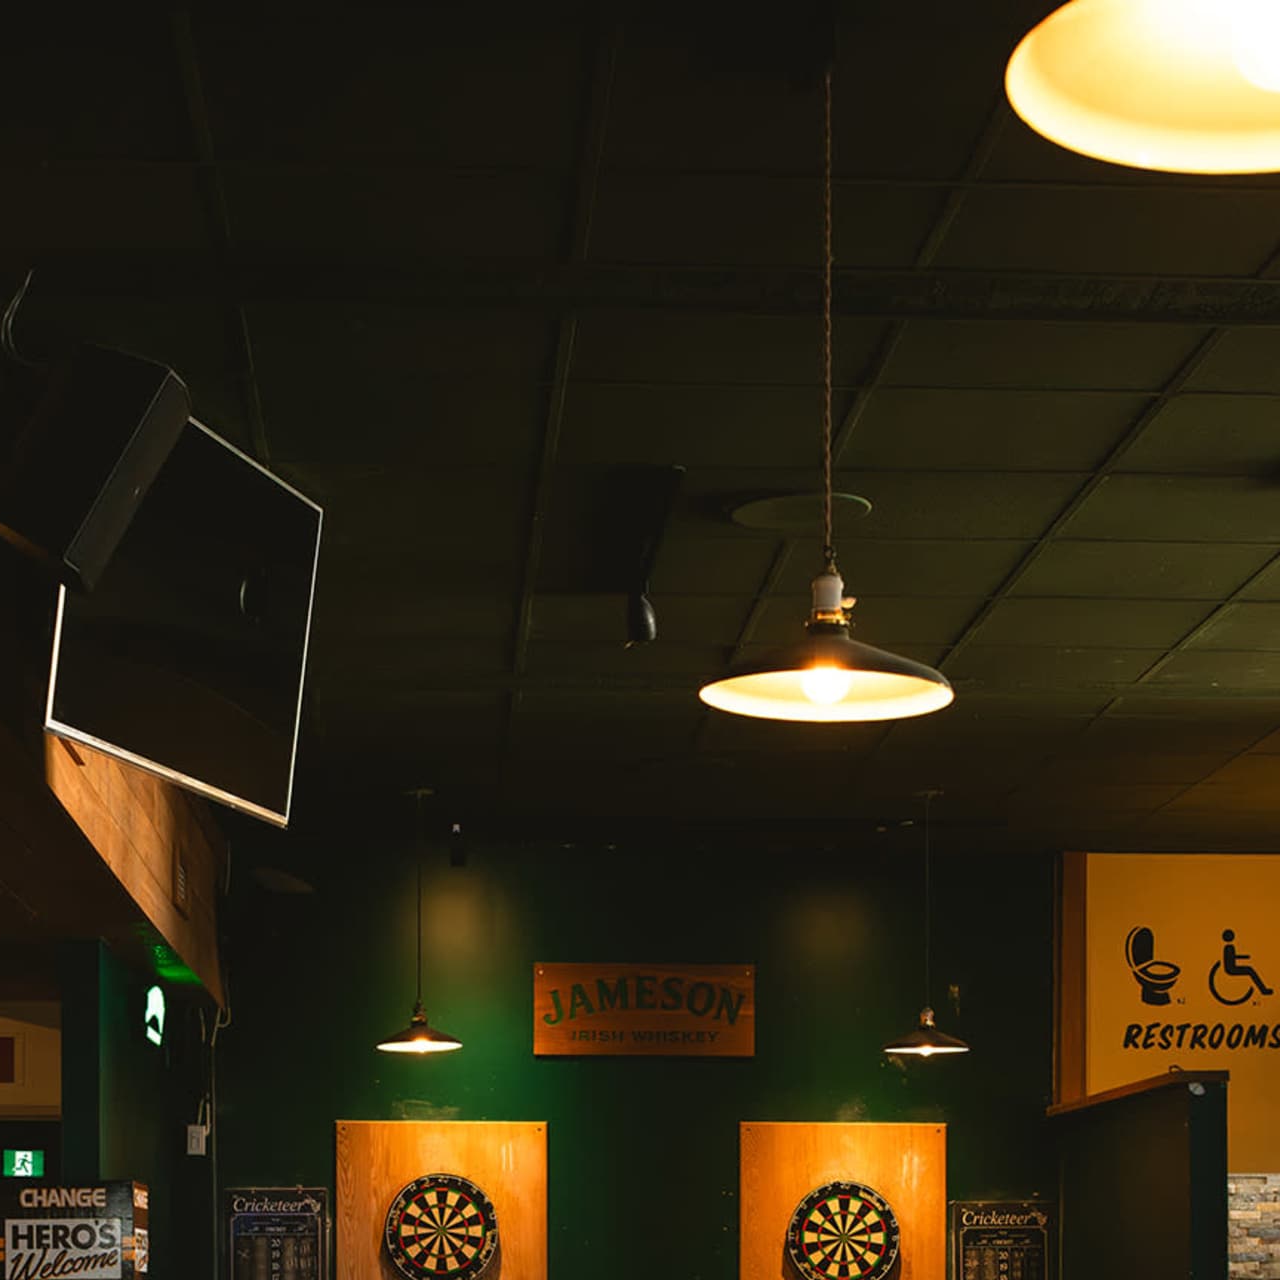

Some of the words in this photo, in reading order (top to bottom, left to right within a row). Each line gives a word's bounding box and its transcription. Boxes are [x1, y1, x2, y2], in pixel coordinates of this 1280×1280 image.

[543, 975, 745, 1025] JAMESON
[572, 1030, 624, 1042] IRISH
[631, 1030, 719, 1042] WHISKEY
[19, 1187, 107, 1208] CHANGE
[232, 1195, 305, 1213] Cricketeer
[960, 1208, 1032, 1226] Cricketeer
[12, 1220, 117, 1250] HERO'S
